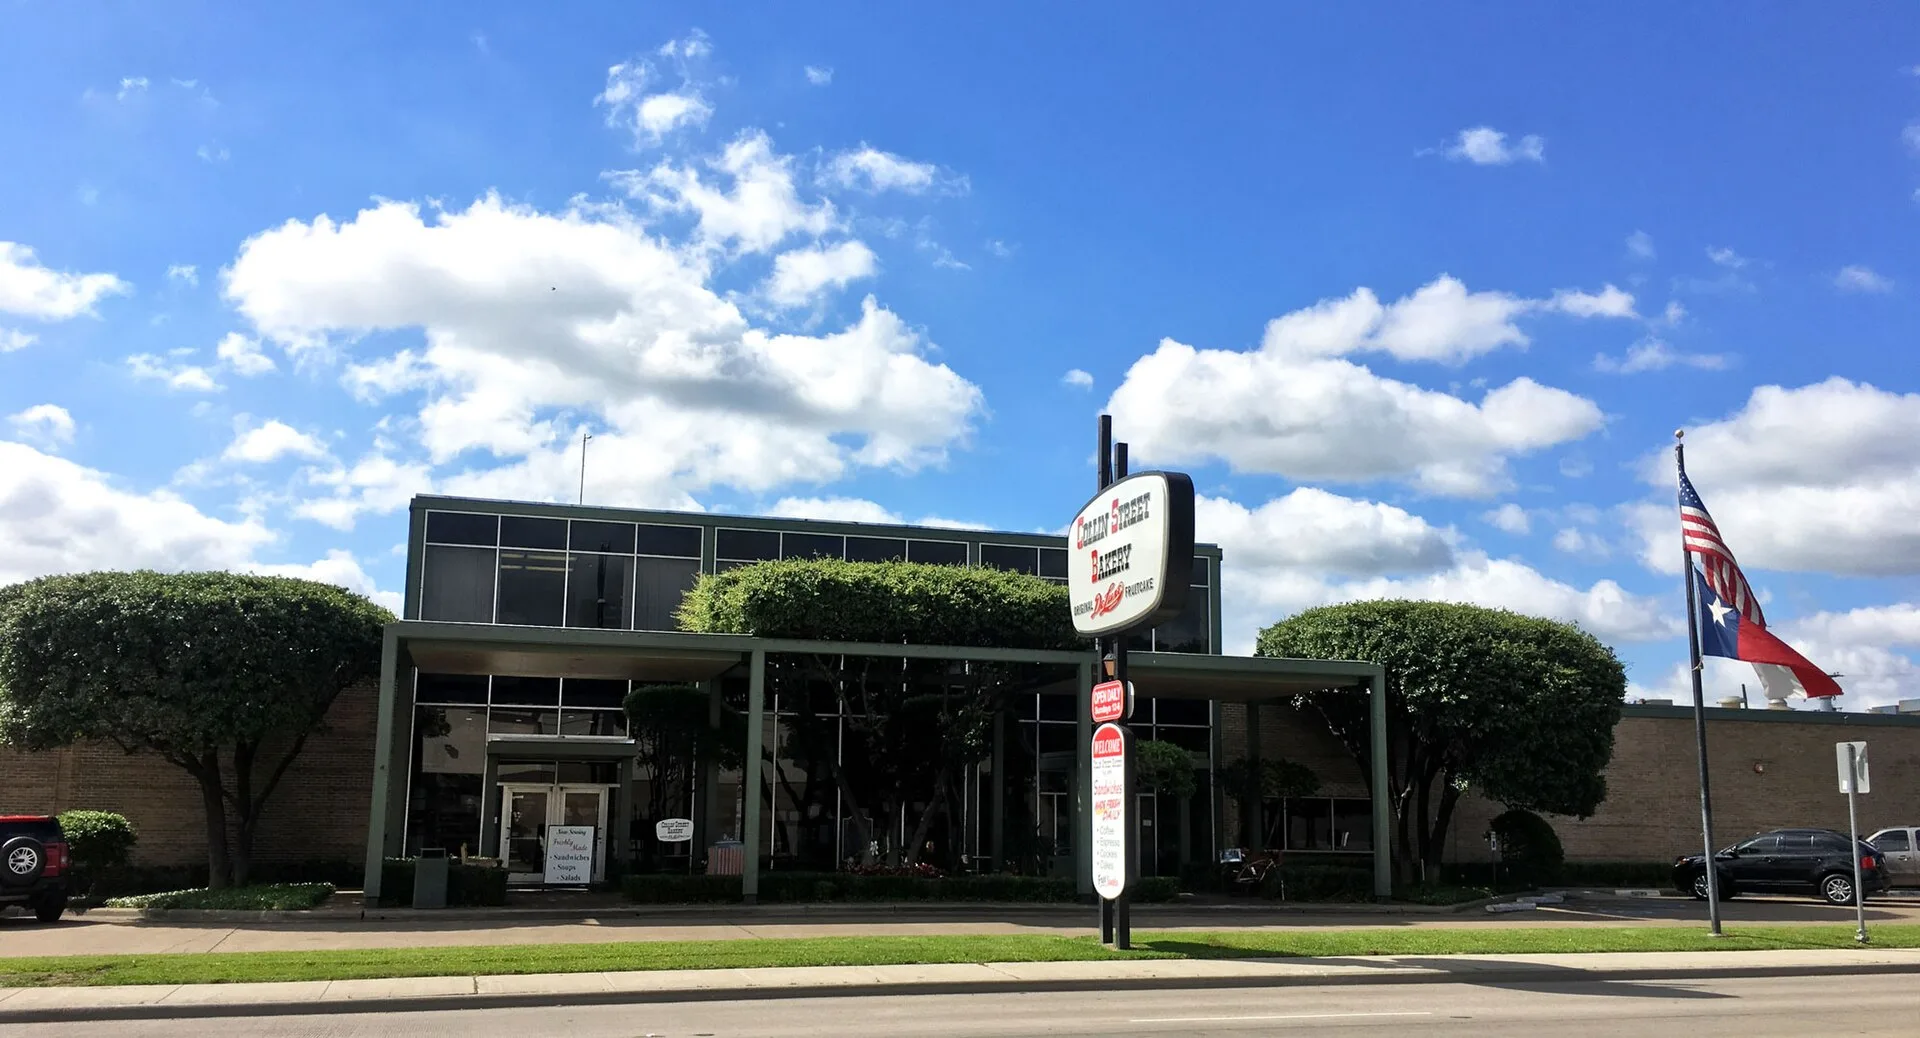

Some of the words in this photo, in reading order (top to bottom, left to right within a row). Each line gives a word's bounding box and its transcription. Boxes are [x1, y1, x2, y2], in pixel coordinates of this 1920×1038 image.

[1077, 512, 1109, 550] COLLIN
[1111, 492, 1151, 534] STREET
[1091, 543, 1132, 584] BAKERY
[1073, 600, 1093, 616] ORIGINAL
[1124, 577, 1154, 598] FRUITCAKE
[1094, 690, 1107, 704] OPEN
[1107, 688, 1121, 702] DAILY
[1094, 738, 1121, 754] WELCOME
